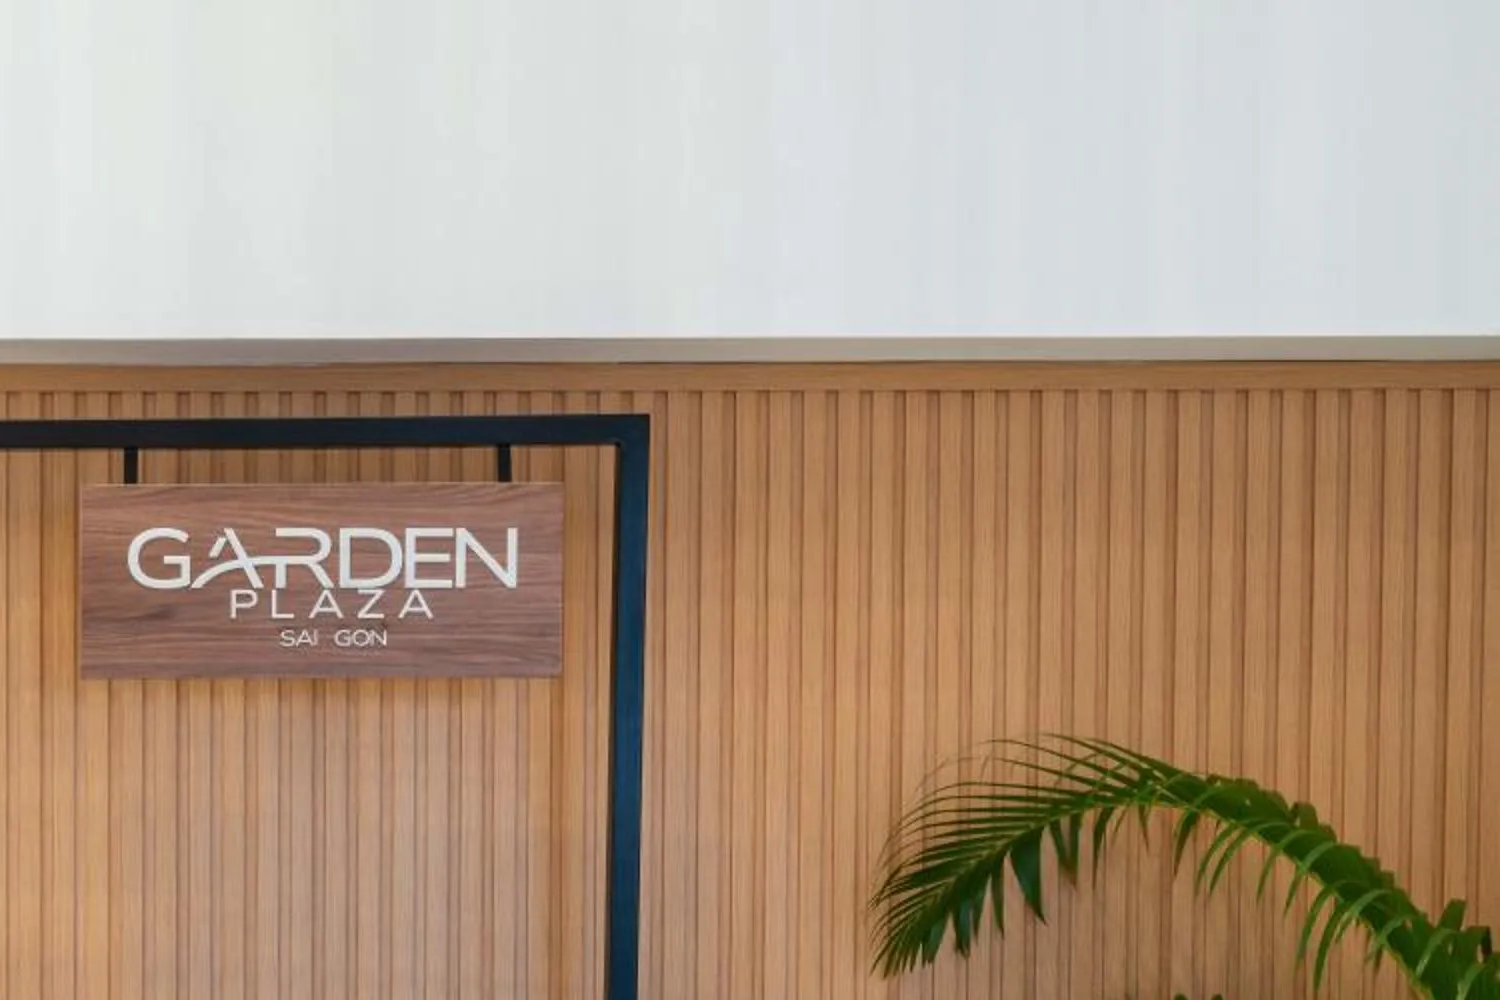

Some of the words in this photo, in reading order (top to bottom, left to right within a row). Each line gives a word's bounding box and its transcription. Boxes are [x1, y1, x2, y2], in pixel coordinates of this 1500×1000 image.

[127, 527, 518, 589] GARDEN
[230, 590, 433, 619] PLAZA
[280, 629, 318, 647] SAI
[334, 629, 388, 647] GON
